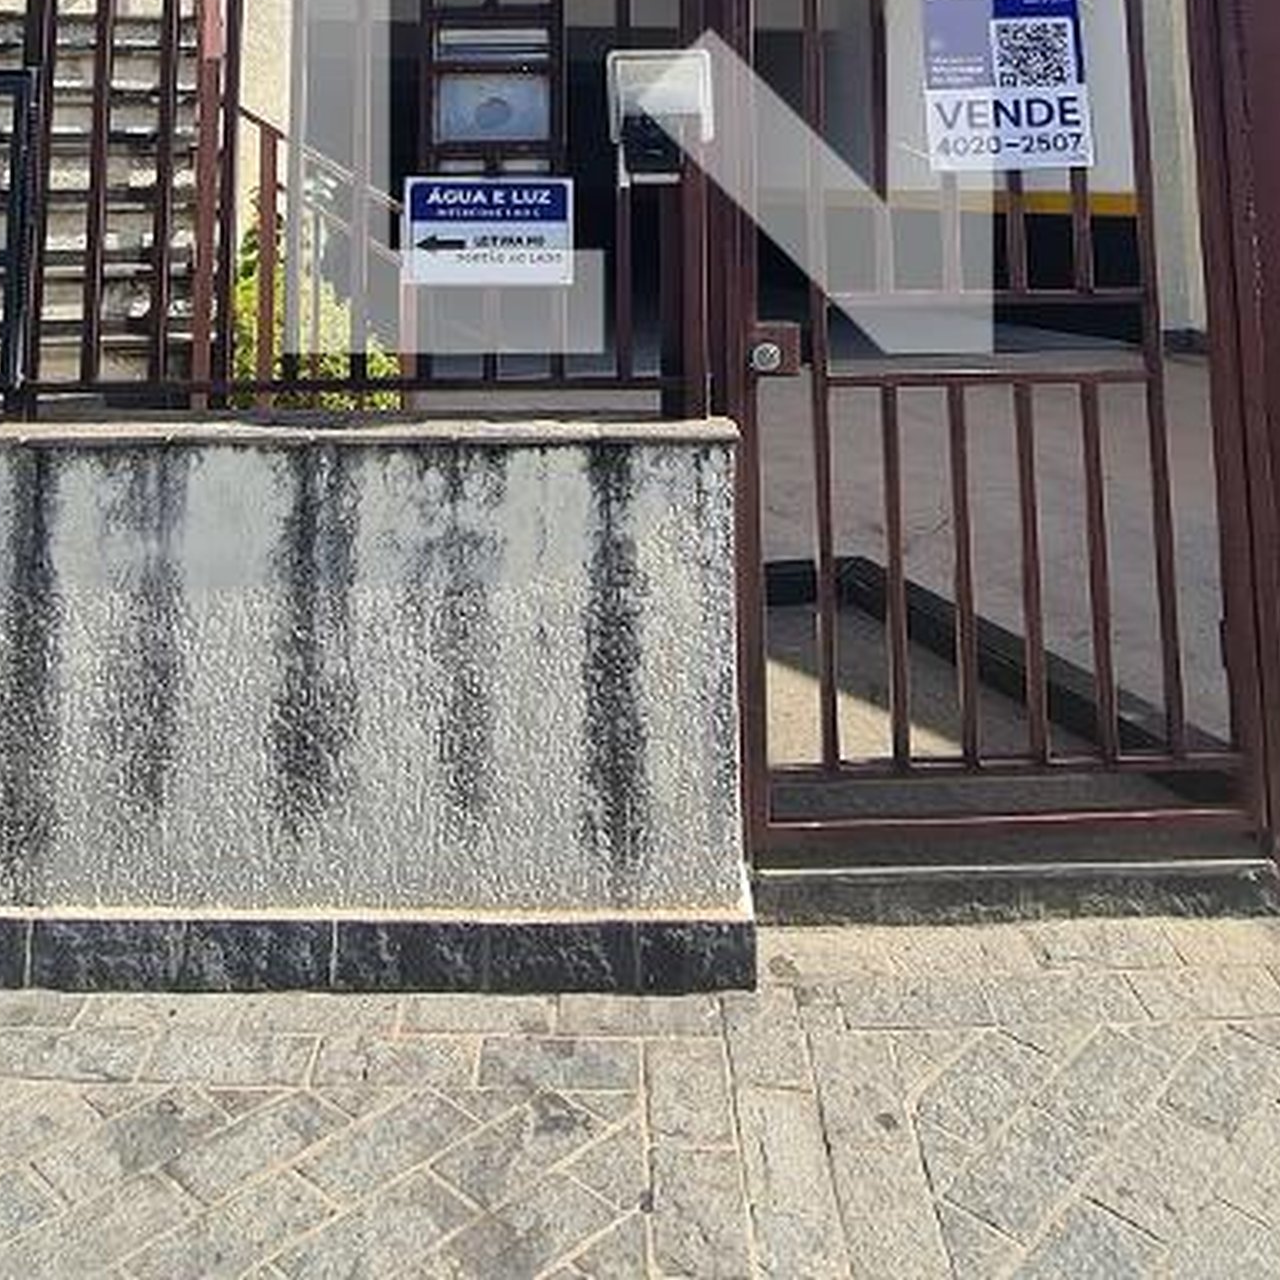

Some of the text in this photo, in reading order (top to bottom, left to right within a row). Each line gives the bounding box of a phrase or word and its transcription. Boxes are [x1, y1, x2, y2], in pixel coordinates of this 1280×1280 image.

[934, 96, 1081, 129] VENDE
[935, 133, 1082, 156] 4020-2507
[426, 187, 551, 205] ÁGUA E LUZ
